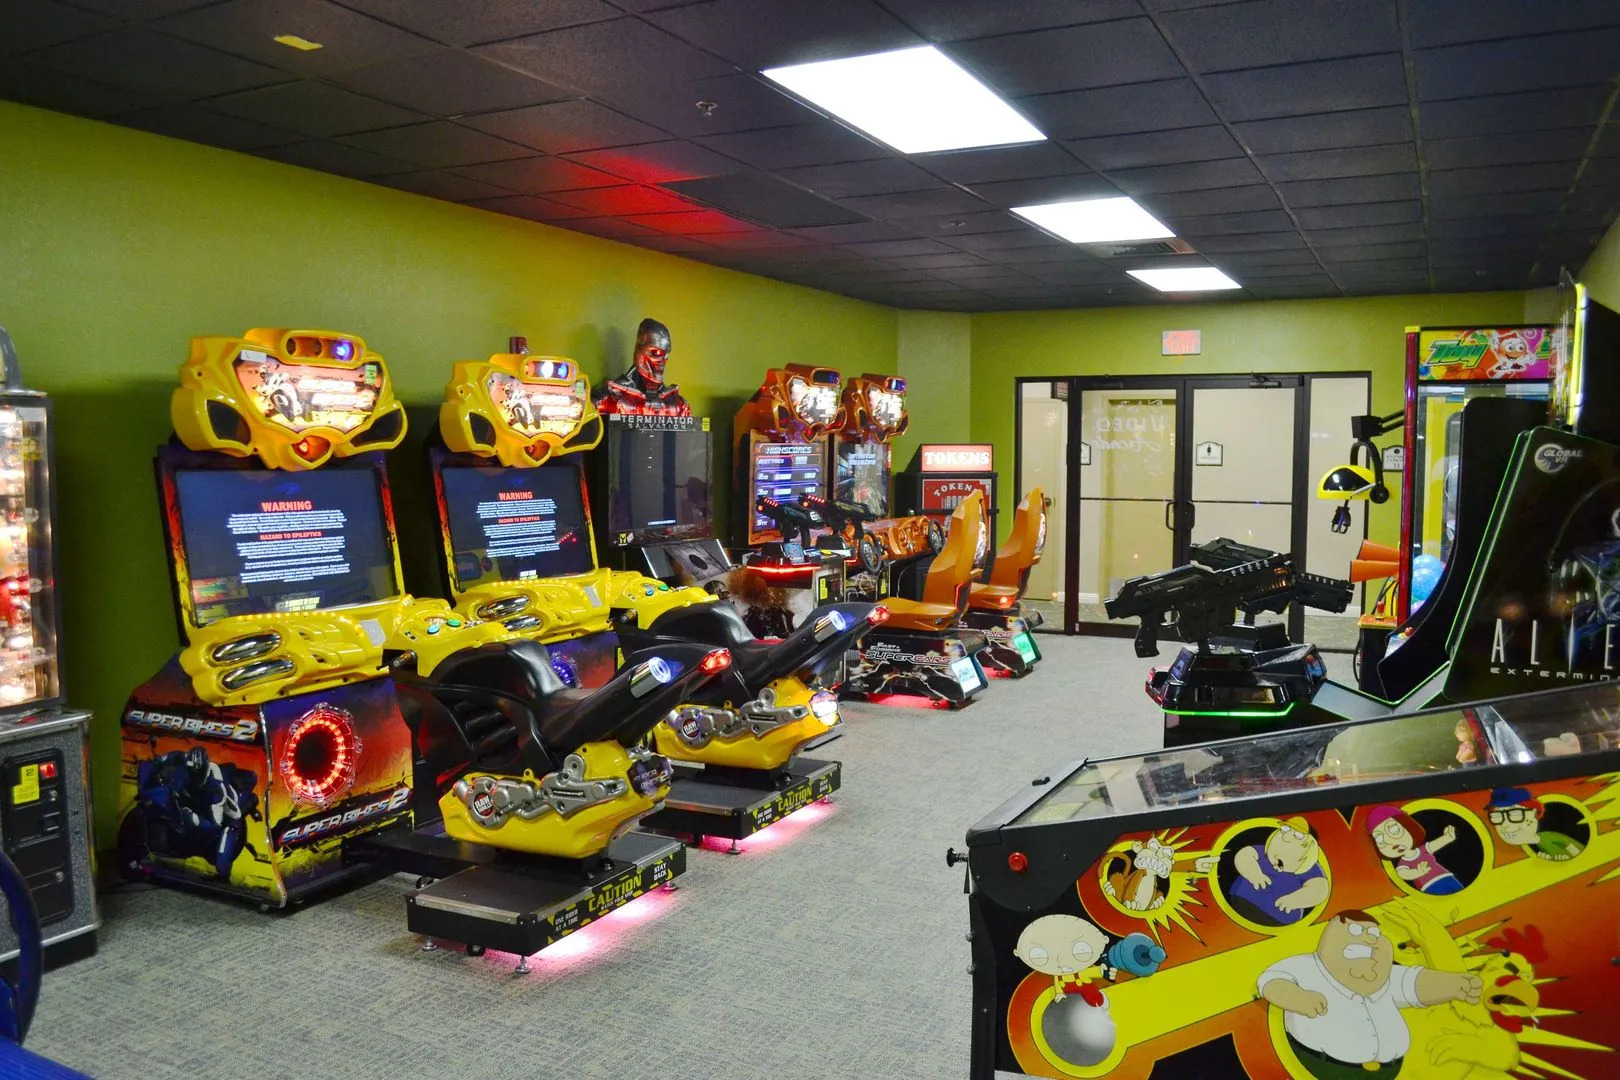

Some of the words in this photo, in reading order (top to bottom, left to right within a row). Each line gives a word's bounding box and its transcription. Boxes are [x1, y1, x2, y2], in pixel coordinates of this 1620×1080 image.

[622, 415, 693, 424] TERMINATOR
[924, 451, 990, 465] TOKENS
[1544, 449, 1583, 457] GLOBAL
[499, 491, 533, 500] WARNING
[933, 482, 979, 497] TOKEN
[261, 501, 312, 512] WARNING
[865, 651, 951, 663] SUPERCARS
[129, 710, 183, 731] SUPER
[184, 719, 235, 736] BIKES
[233, 720, 257, 740] 2
[475, 795, 490, 808] RAW
[778, 786, 812, 811] CAUTION
[282, 815, 342, 842] SUPER
[341, 799, 391, 825] BIKES
[388, 788, 410, 811] 2
[654, 863, 667, 873] STAY
[654, 869, 667, 880] BACK
[588, 874, 642, 912] CAUTION
